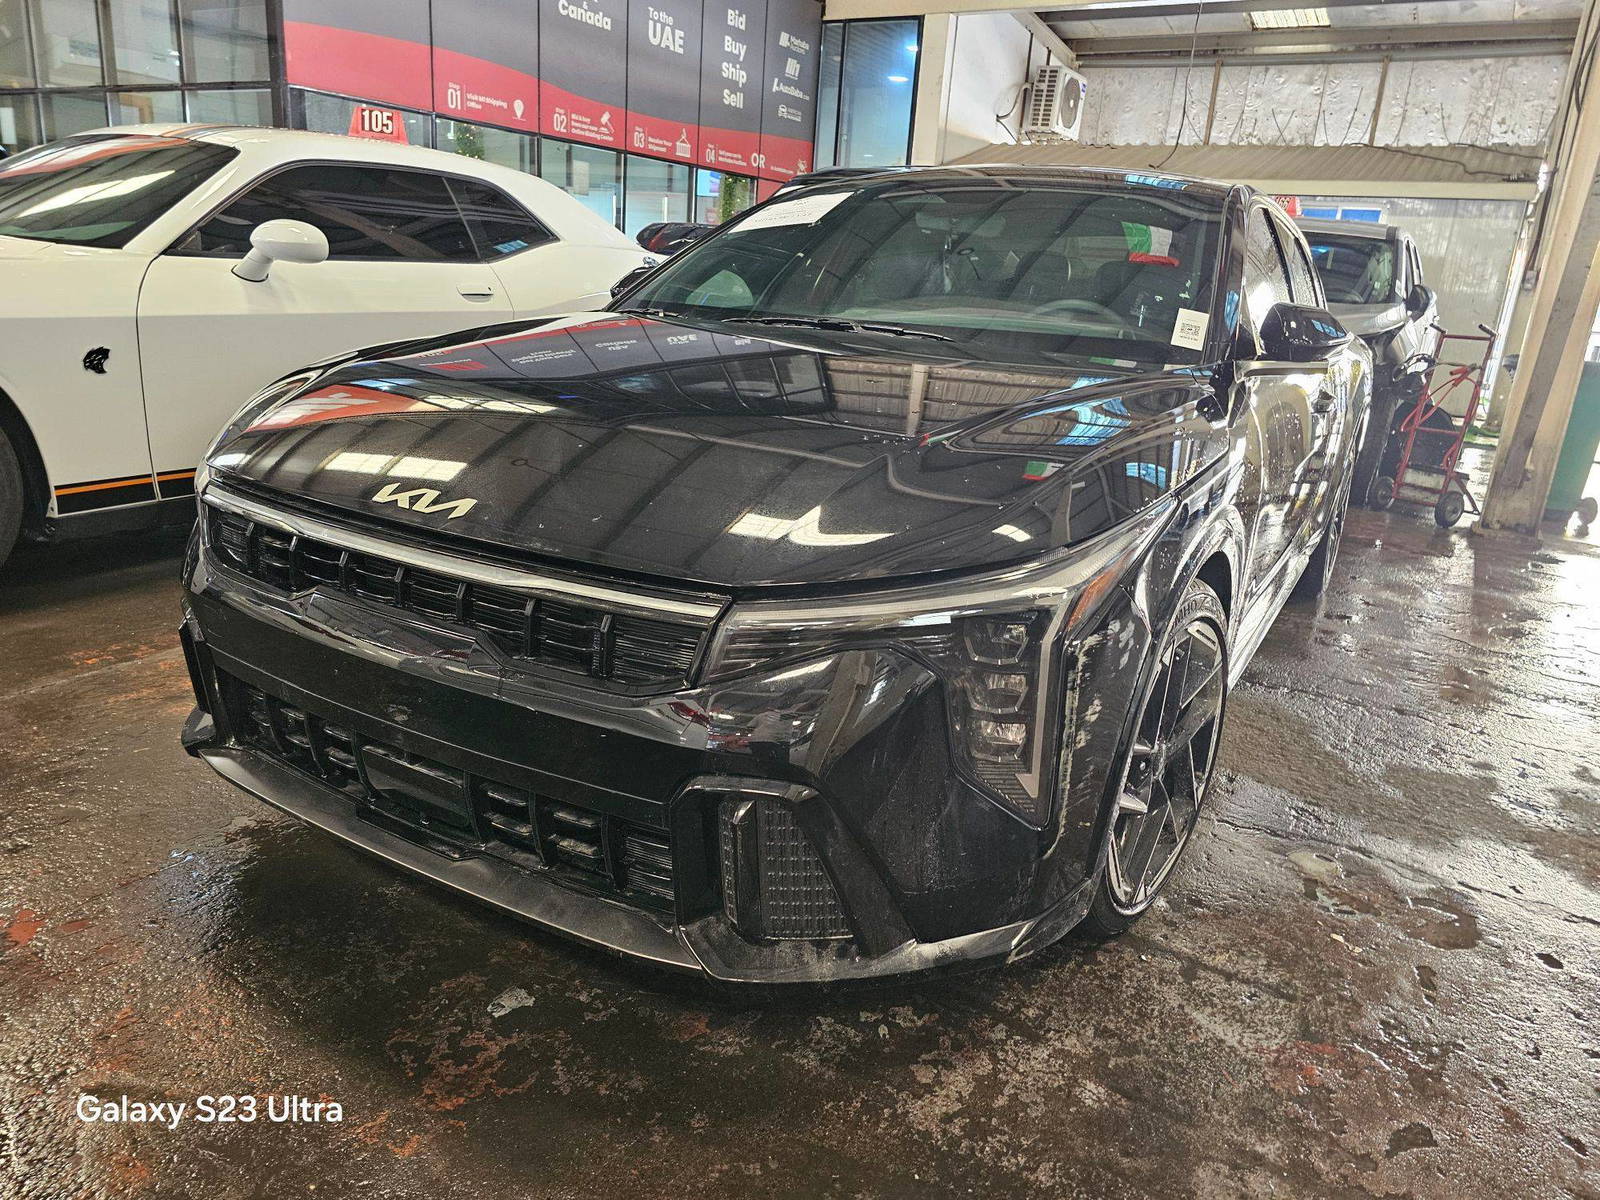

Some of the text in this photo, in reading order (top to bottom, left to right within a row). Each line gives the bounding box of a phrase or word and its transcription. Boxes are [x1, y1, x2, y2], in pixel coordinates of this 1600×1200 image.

[558, 0, 612, 31] Canada
[648, 7, 674, 26] To the
[727, 8, 746, 31] Bid
[648, 20, 685, 55] UAE
[724, 35, 747, 62] Buy
[721, 61, 747, 88] Ship
[447, 88, 461, 111] 01
[723, 88, 744, 109] Sell
[362, 109, 394, 134] 105
[553, 113, 567, 133] 02
[633, 131, 645, 148] 03
[705, 149, 716, 164] 04
[751, 152, 766, 169] OR
